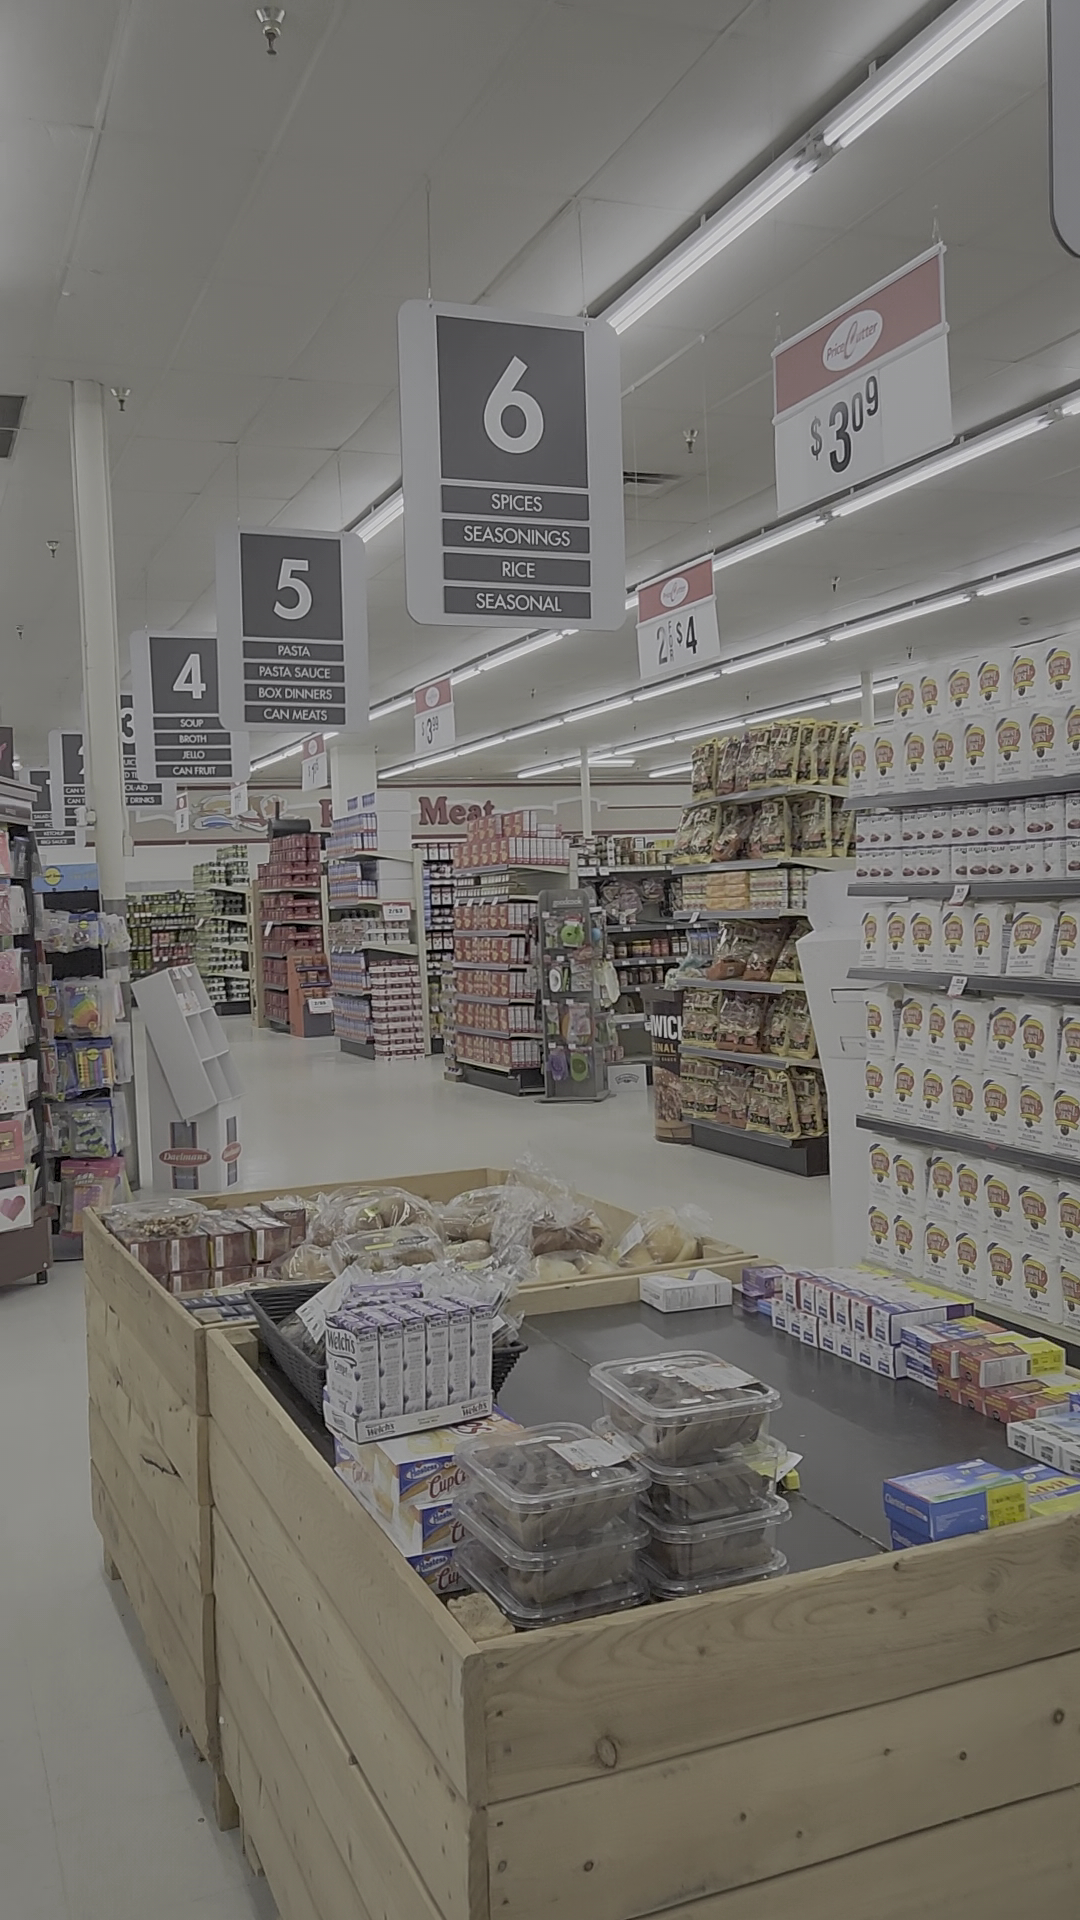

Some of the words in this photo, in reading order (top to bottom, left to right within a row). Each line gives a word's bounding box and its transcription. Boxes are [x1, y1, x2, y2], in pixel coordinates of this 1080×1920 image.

[826, 343, 845, 362] Price
[483, 355, 545, 455] 6
[491, 493, 543, 512] SPICES
[463, 525, 571, 547] SEASONINGS
[501, 561, 536, 579] RICE
[273, 558, 313, 620] 5
[475, 593, 562, 613] SEASONAL
[277, 645, 311, 657] PASTA
[172, 653, 207, 699] 4
[258, 665, 291, 678] PASTA
[294, 667, 331, 680] SAUCE
[258, 687, 284, 699] BOX
[286, 688, 333, 701] DINNERS
[263, 708, 290, 721] CAN
[292, 709, 328, 722] MEATS
[120, 707, 135, 744] 3
[180, 718, 204, 729] SOUP
[179, 733, 207, 744] BROTH
[182, 749, 206, 761] JELLO
[172, 765, 192, 776] CAN
[193, 765, 217, 776] FRUIT
[65, 787, 80, 795] CAN
[128, 796, 155, 805] DRINKS
[418, 796, 496, 827] Meat
[327, 1329, 356, 1355] Welch's
[462, 1403, 488, 1417] Welch's
[366, 1422, 395, 1437] Welch's
[409, 1463, 440, 1477] Hostess
[419, 1556, 447, 1571] Hostess
